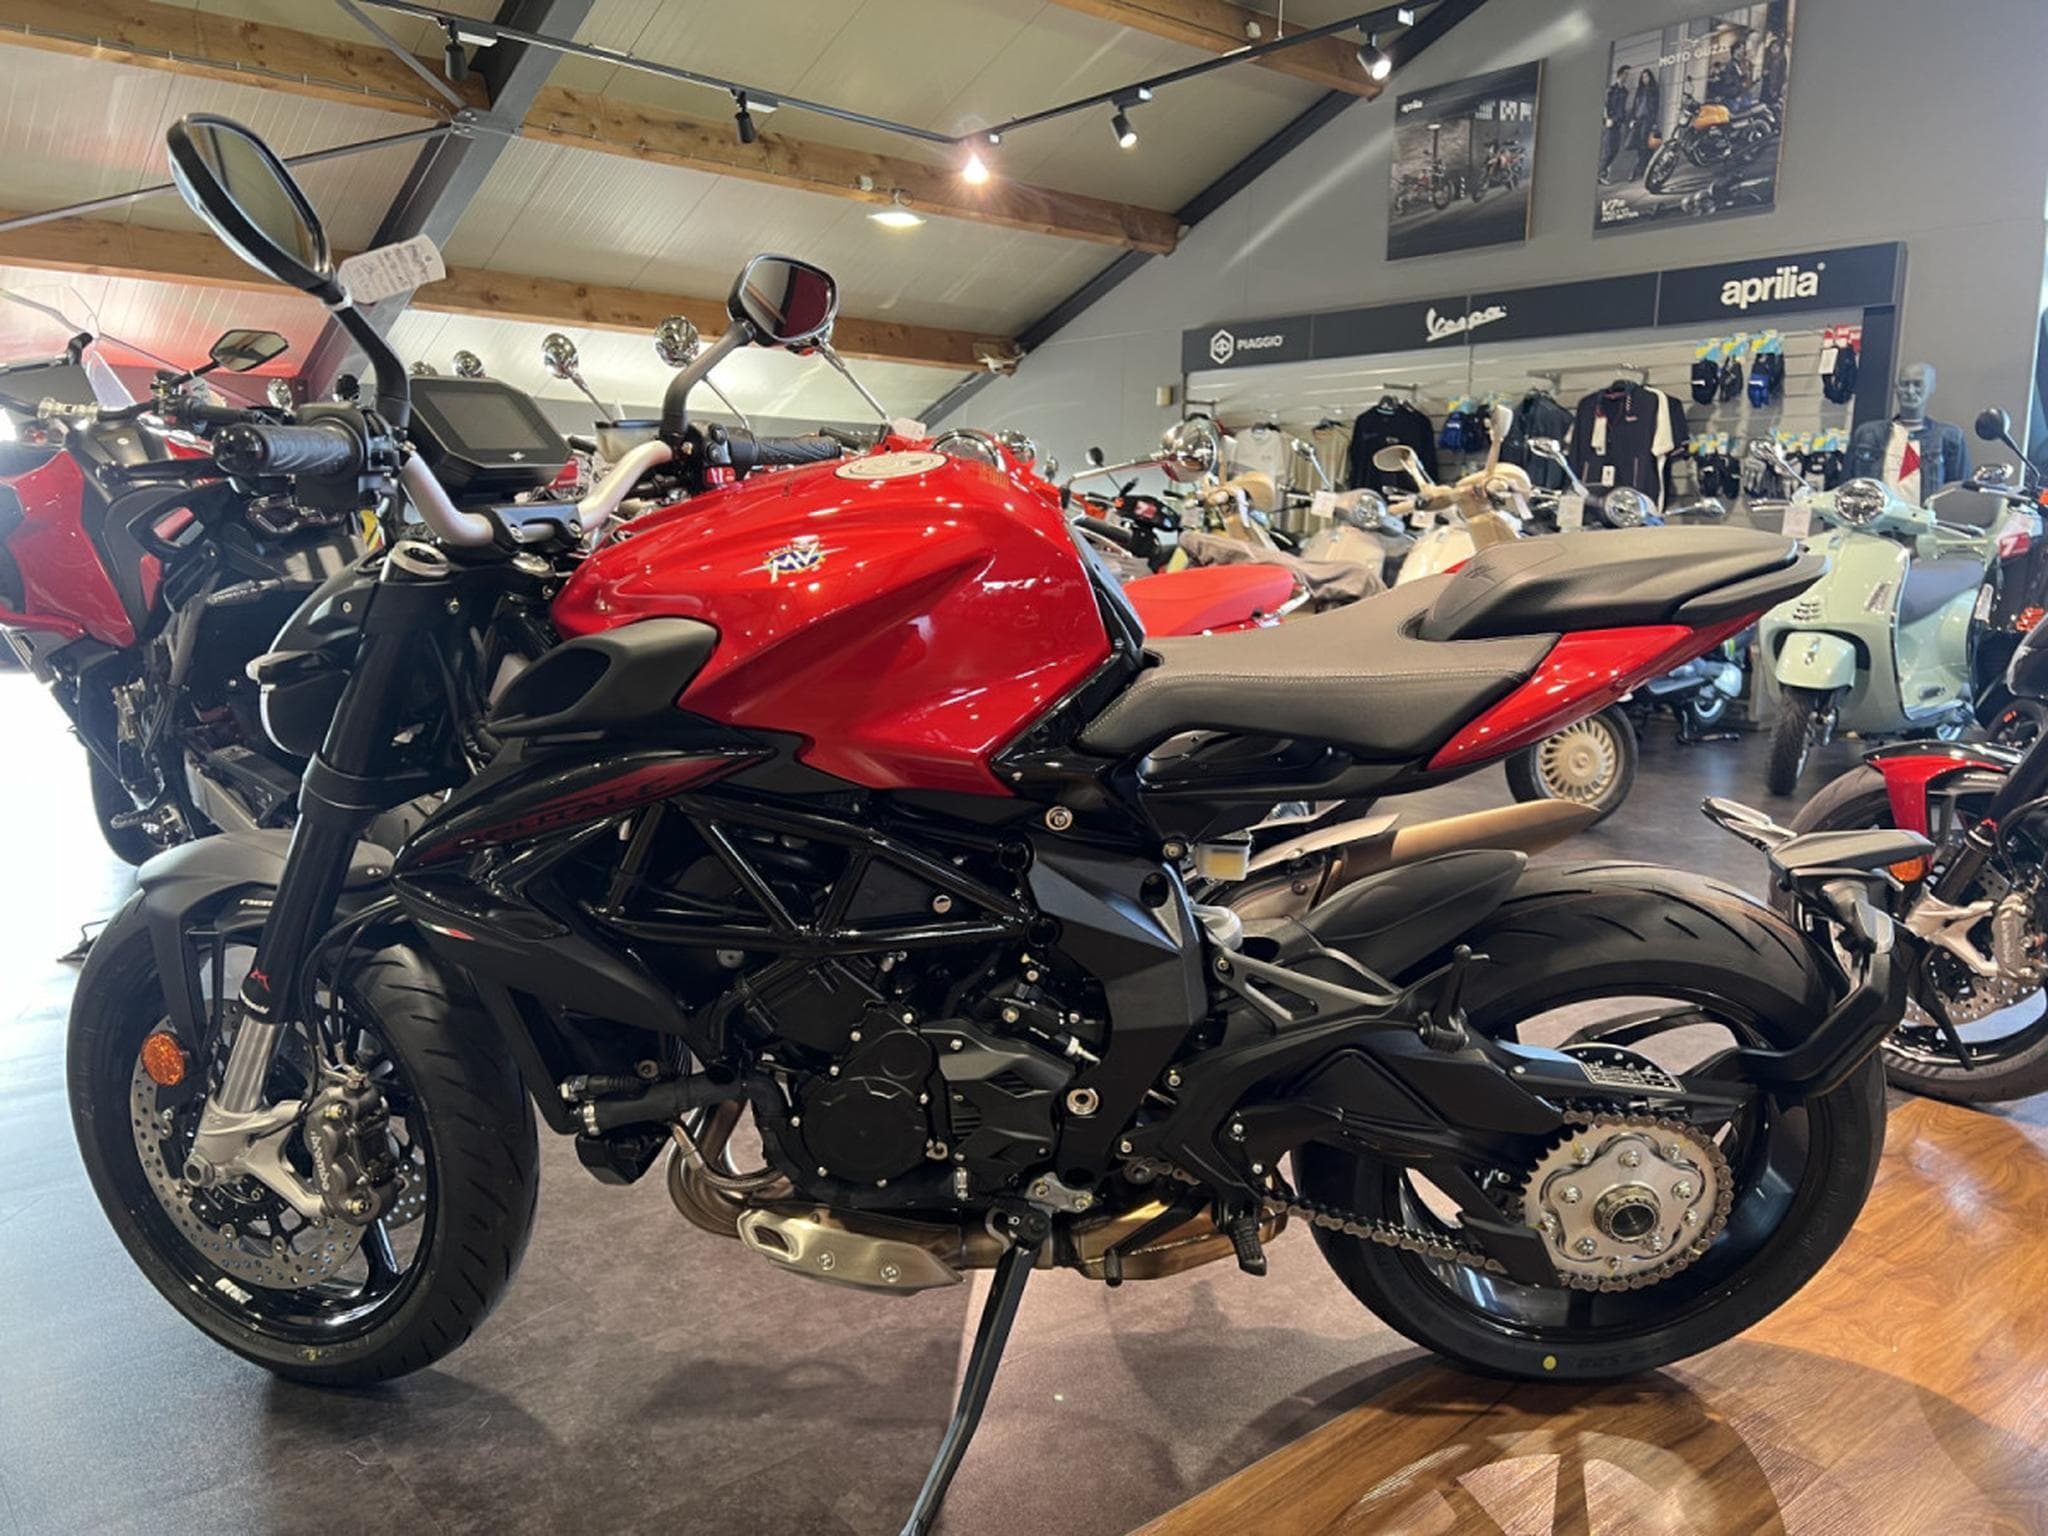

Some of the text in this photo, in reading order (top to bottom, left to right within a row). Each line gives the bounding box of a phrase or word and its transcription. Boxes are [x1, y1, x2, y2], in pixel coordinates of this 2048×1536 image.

[1659, 51, 1690, 67] MOTO
[1721, 265, 1819, 309] aprilia
[1426, 307, 1507, 342] Vespa
[1236, 335, 1283, 350] PIAGGIO
[310, 1130, 331, 1192] brembo
